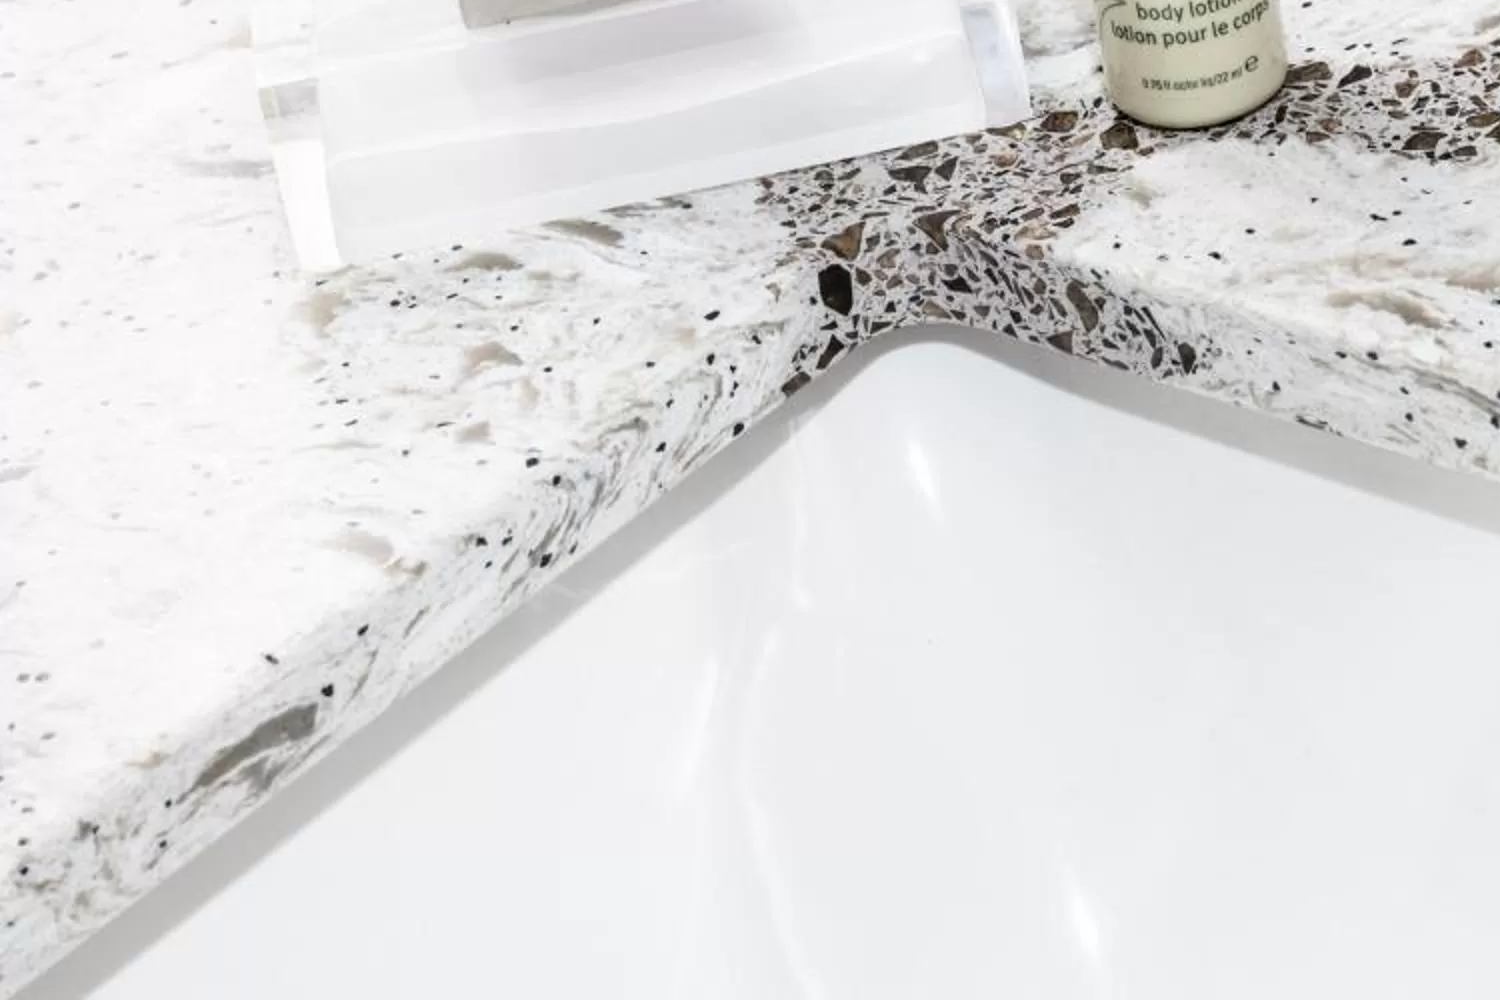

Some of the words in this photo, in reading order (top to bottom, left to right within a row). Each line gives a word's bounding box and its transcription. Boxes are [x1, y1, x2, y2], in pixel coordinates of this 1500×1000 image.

[1135, 1, 1184, 23] body
[1110, 19, 1157, 46] lotion
[1162, 26, 1208, 49] pour
[1211, 20, 1229, 38] le
